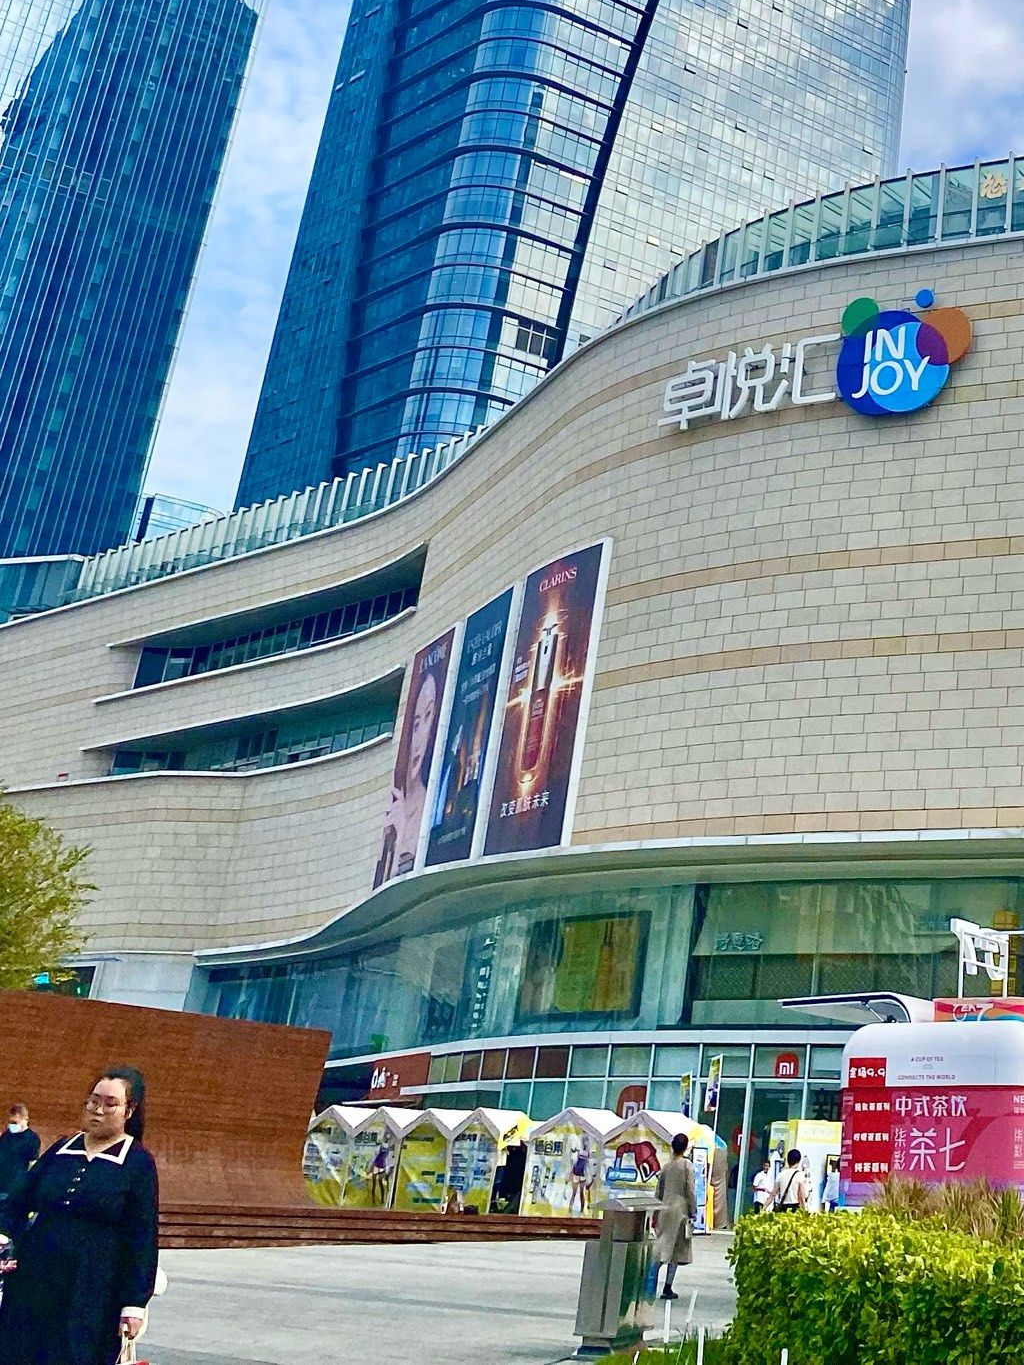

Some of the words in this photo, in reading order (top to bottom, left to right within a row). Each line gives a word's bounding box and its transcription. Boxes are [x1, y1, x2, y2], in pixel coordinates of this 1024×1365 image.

[863, 326, 906, 364] IN
[657, 333, 843, 431] 卓悦汇
[851, 355, 932, 400] JOY
[538, 567, 578, 592] CLARINS
[894, 1095, 968, 1117] 中式茶饮
[908, 1127, 966, 1171] 茶七
